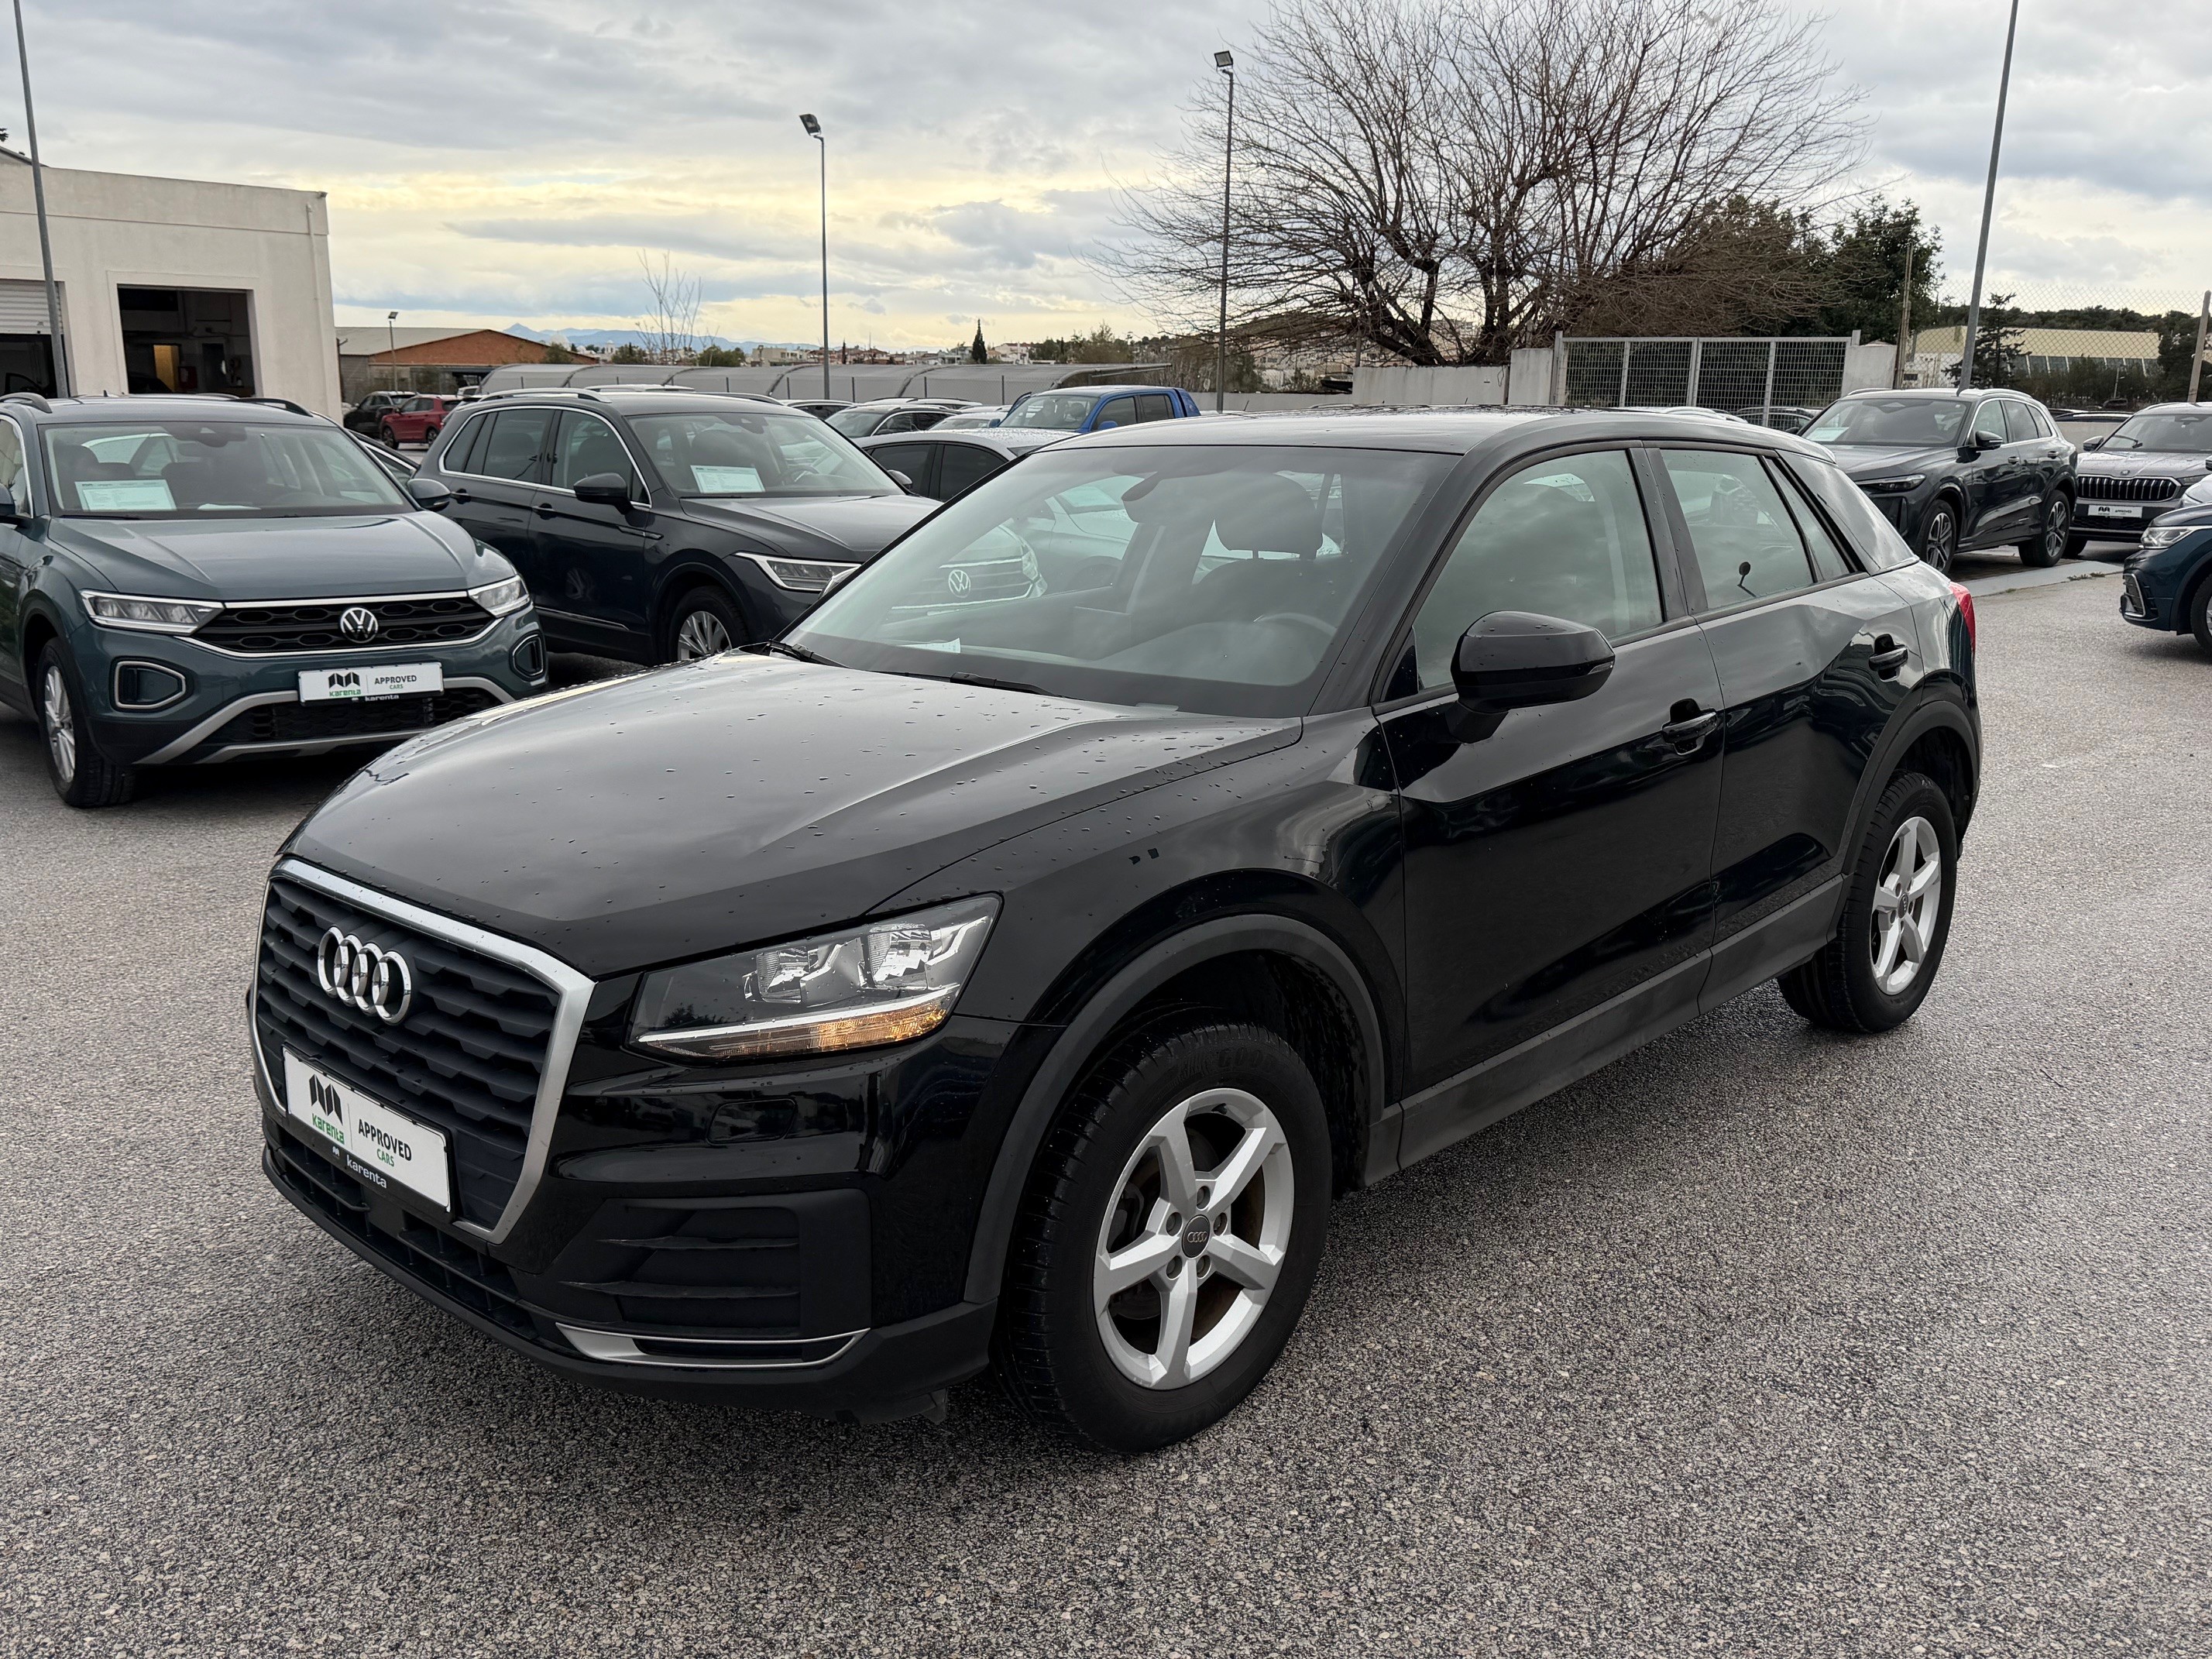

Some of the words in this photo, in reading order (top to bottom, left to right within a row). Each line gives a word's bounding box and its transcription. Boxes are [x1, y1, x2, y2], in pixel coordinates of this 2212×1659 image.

[374, 675, 417, 685] APPROVED
[311, 1113, 345, 1146] karenta
[358, 1118, 412, 1162] APPROVED
[346, 1154, 387, 1189] karenta
[376, 1148, 395, 1167] CARS
